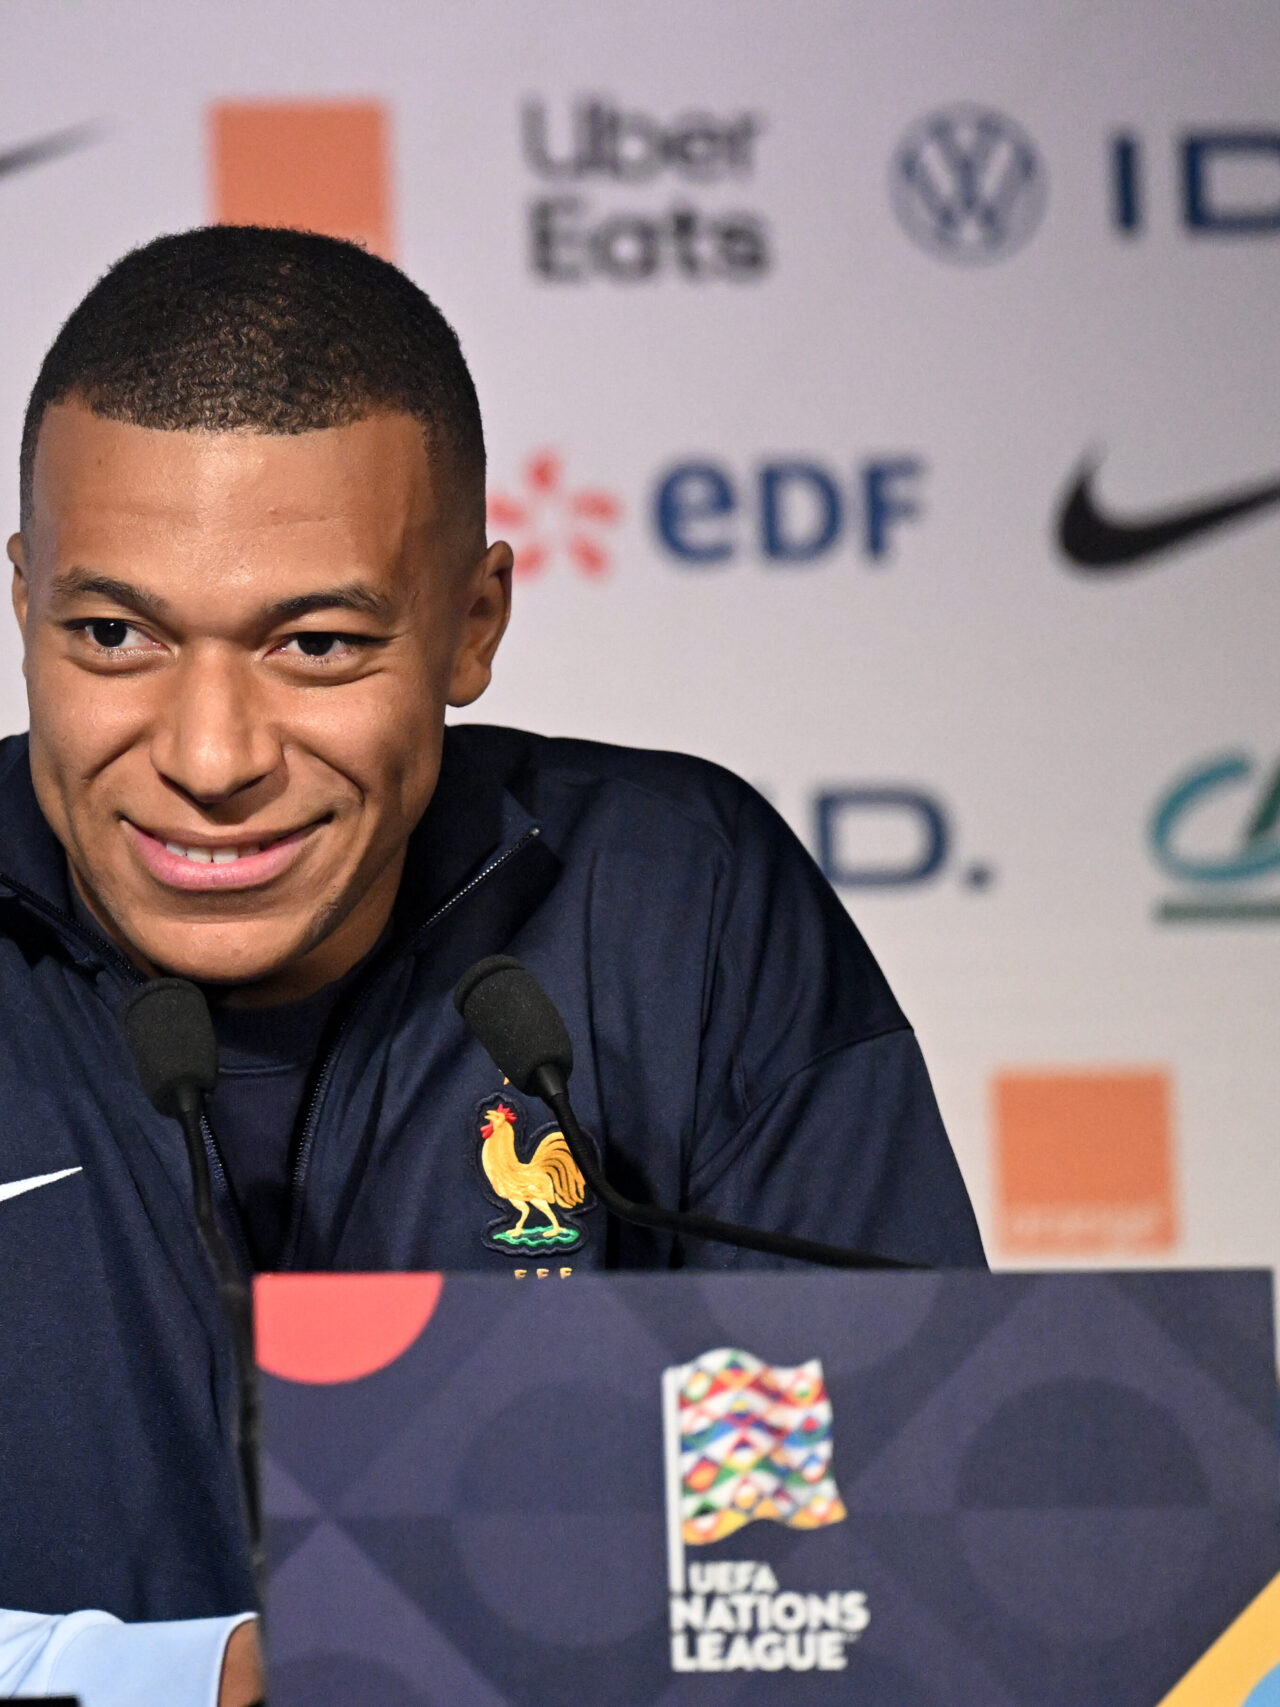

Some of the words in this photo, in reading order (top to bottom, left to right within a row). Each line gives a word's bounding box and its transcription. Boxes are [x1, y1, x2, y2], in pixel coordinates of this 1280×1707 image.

[522, 96, 763, 182] Uber
[528, 196, 773, 283] Eats
[688, 1561, 778, 1594] UEFA
[670, 1591, 870, 1633] NATIONS
[671, 1630, 848, 1672] LEAGUE
